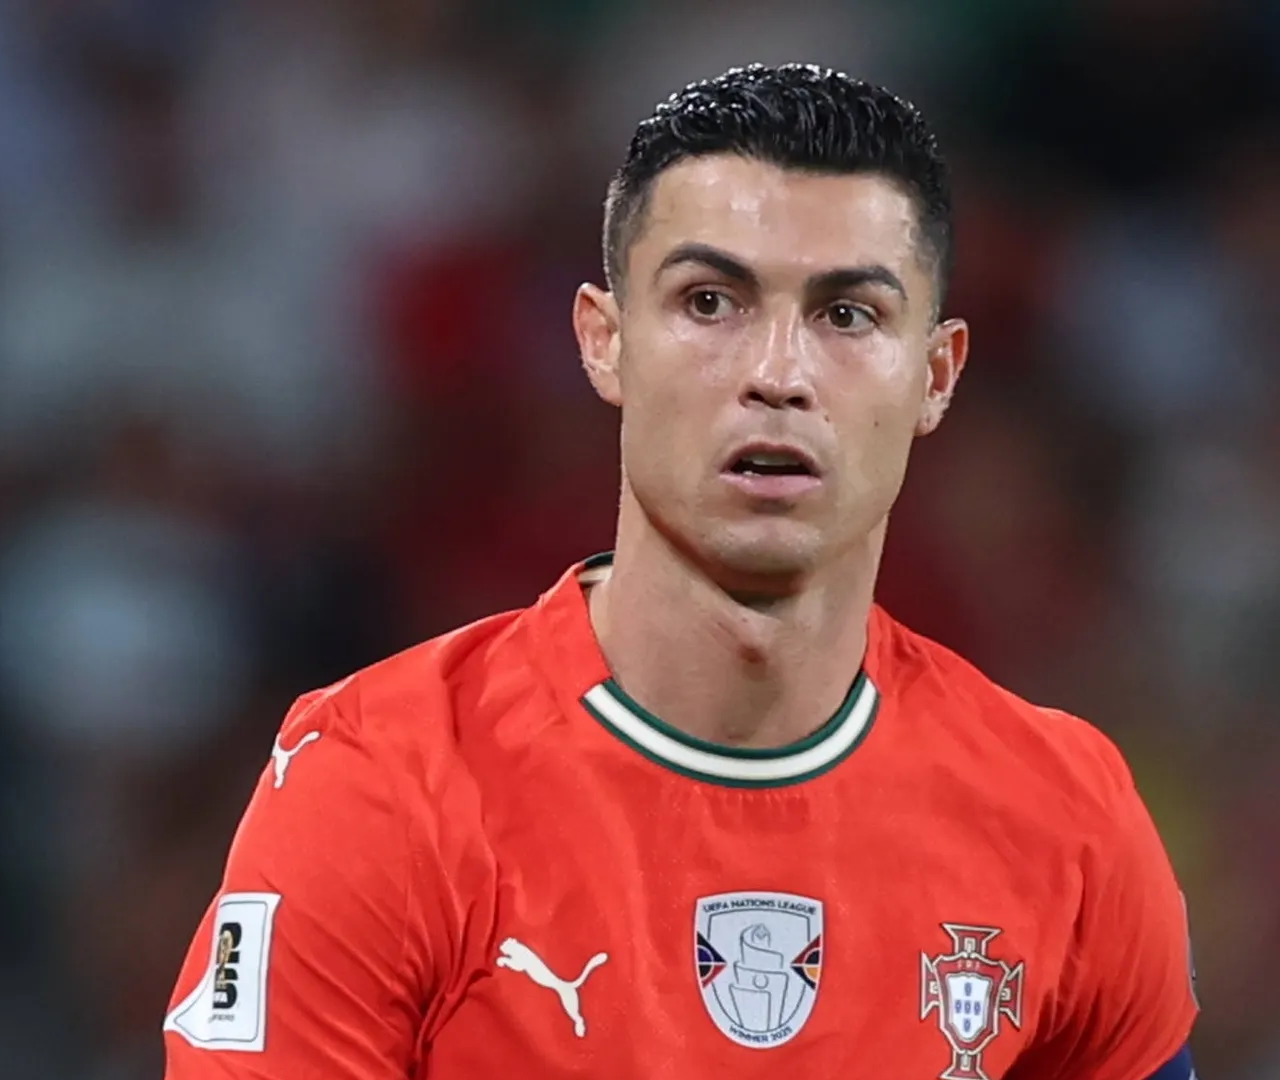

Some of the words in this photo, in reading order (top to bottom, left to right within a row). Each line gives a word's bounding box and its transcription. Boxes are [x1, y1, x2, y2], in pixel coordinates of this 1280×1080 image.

[703, 901, 728, 912] UEFA
[731, 899, 776, 908] NATIONS
[778, 901, 816, 915] LEAGUE
[729, 1025, 769, 1042] WINNER
[770, 1026, 793, 1041] 2025
